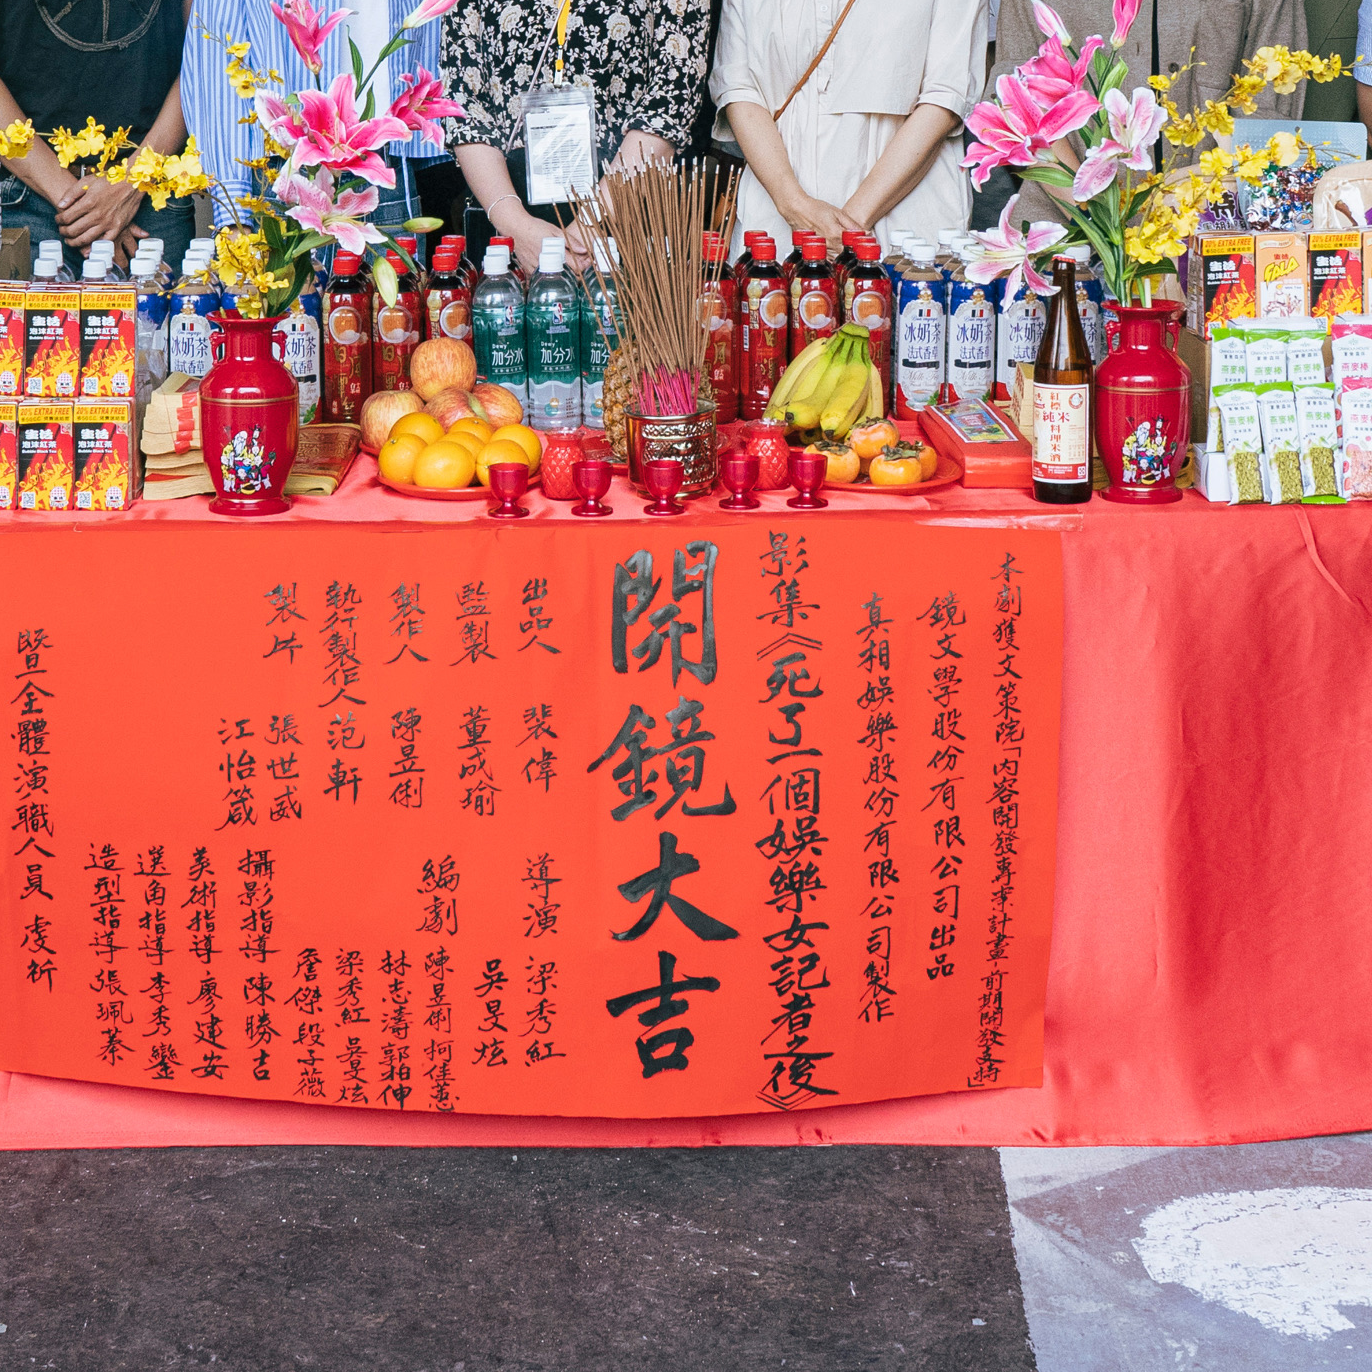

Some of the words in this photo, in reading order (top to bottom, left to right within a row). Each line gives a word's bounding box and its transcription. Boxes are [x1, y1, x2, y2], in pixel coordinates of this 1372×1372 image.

[8, 292, 24, 302] FREE
[83, 293, 95, 302] 20%
[96, 293, 115, 302] EXTRA
[117, 293, 132, 302] FREE
[1263, 256, 1300, 283] FALA
[171, 336, 209, 358] 冰奶茶
[492, 349, 524, 366] 加分水
[540, 347, 575, 365] 加分水
[904, 323, 941, 344] 冰奶茶
[908, 345, 938, 360] 法式香草
[956, 323, 992, 344] 冰奶茶
[960, 346, 991, 360] 法式香草
[1293, 363, 1322, 373] 燕麥棒
[1341, 362, 1369, 372] 燕麥棒
[20, 407, 33, 416] 20%
[34, 407, 53, 416] EXTRA
[54, 407, 69, 416] FREE
[1043, 411, 1070, 423] 純米
[1050, 424, 1061, 462] 料理米酒
[1228, 416, 1255, 426] 燕麥棒
[1306, 411, 1332, 421] 燕麥棒
[264, 583, 305, 663] 製片
[319, 581, 366, 707] 執行製作人
[388, 584, 428, 663] 製作人
[457, 582, 496, 663] 監製
[520, 579, 560, 653] 出品人
[12, 629, 54, 900] 暨全體演職人員
[458, 706, 500, 815] 董成瑜
[524, 704, 557, 792] 裴偉
[587, 541, 739, 1078] 開鏡大吉
[857, 593, 899, 1022] 真相娛樂股份有限公司製作
[917, 598, 966, 980] 鏡文學股份有限公司出品
[85, 844, 125, 963] 造型指導
[134, 846, 172, 965] 選角指導
[181, 847, 220, 964] 美術指導
[238, 850, 277, 962] 攝影指導
[416, 855, 460, 935] 編劇
[522, 856, 561, 936] 導演
[21, 915, 57, 991] 虔祈
[284, 948, 322, 1014] 詹傑
[336, 951, 370, 1027] 梁秀紅
[425, 946, 453, 1025] 陳昱俐
[188, 971, 228, 1079] 廖建安
[244, 973, 280, 1080] 陳勝吉
[381, 950, 411, 1039] 林志濤
[472, 959, 508, 1066] 吳旻炫
[525, 956, 566, 1066] 梁秀紅
[293, 1023, 325, 1097] 段子薇
